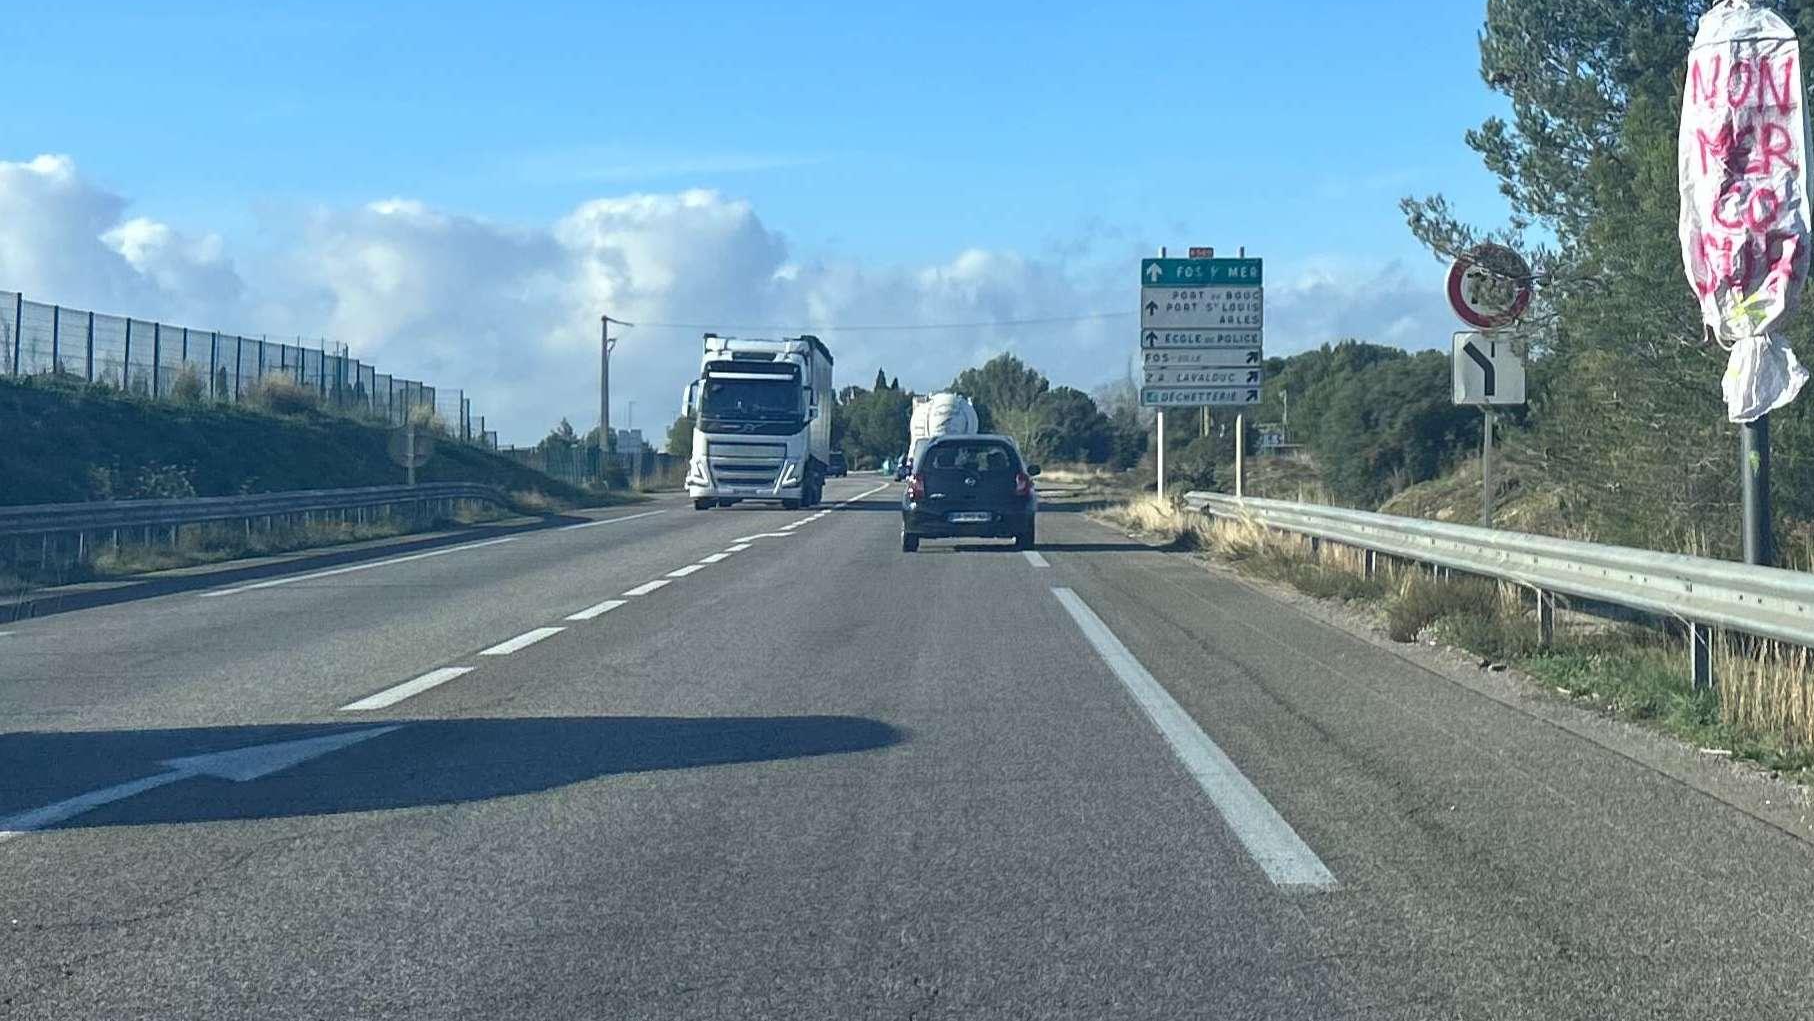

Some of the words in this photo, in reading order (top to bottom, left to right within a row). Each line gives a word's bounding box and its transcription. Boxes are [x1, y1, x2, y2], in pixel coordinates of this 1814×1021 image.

[1692, 53, 1794, 116] NON
[1712, 181, 1779, 233] CO
[1176, 266, 1202, 278] FOS
[1228, 266, 1258, 278] MER
[1172, 291, 1205, 300] PORT
[1226, 291, 1260, 300] BOUC
[1166, 303, 1197, 312] PORT
[1222, 303, 1260, 312] LOUIS
[1219, 315, 1259, 325] ARLES
[1217, 333, 1259, 343] POLICE
